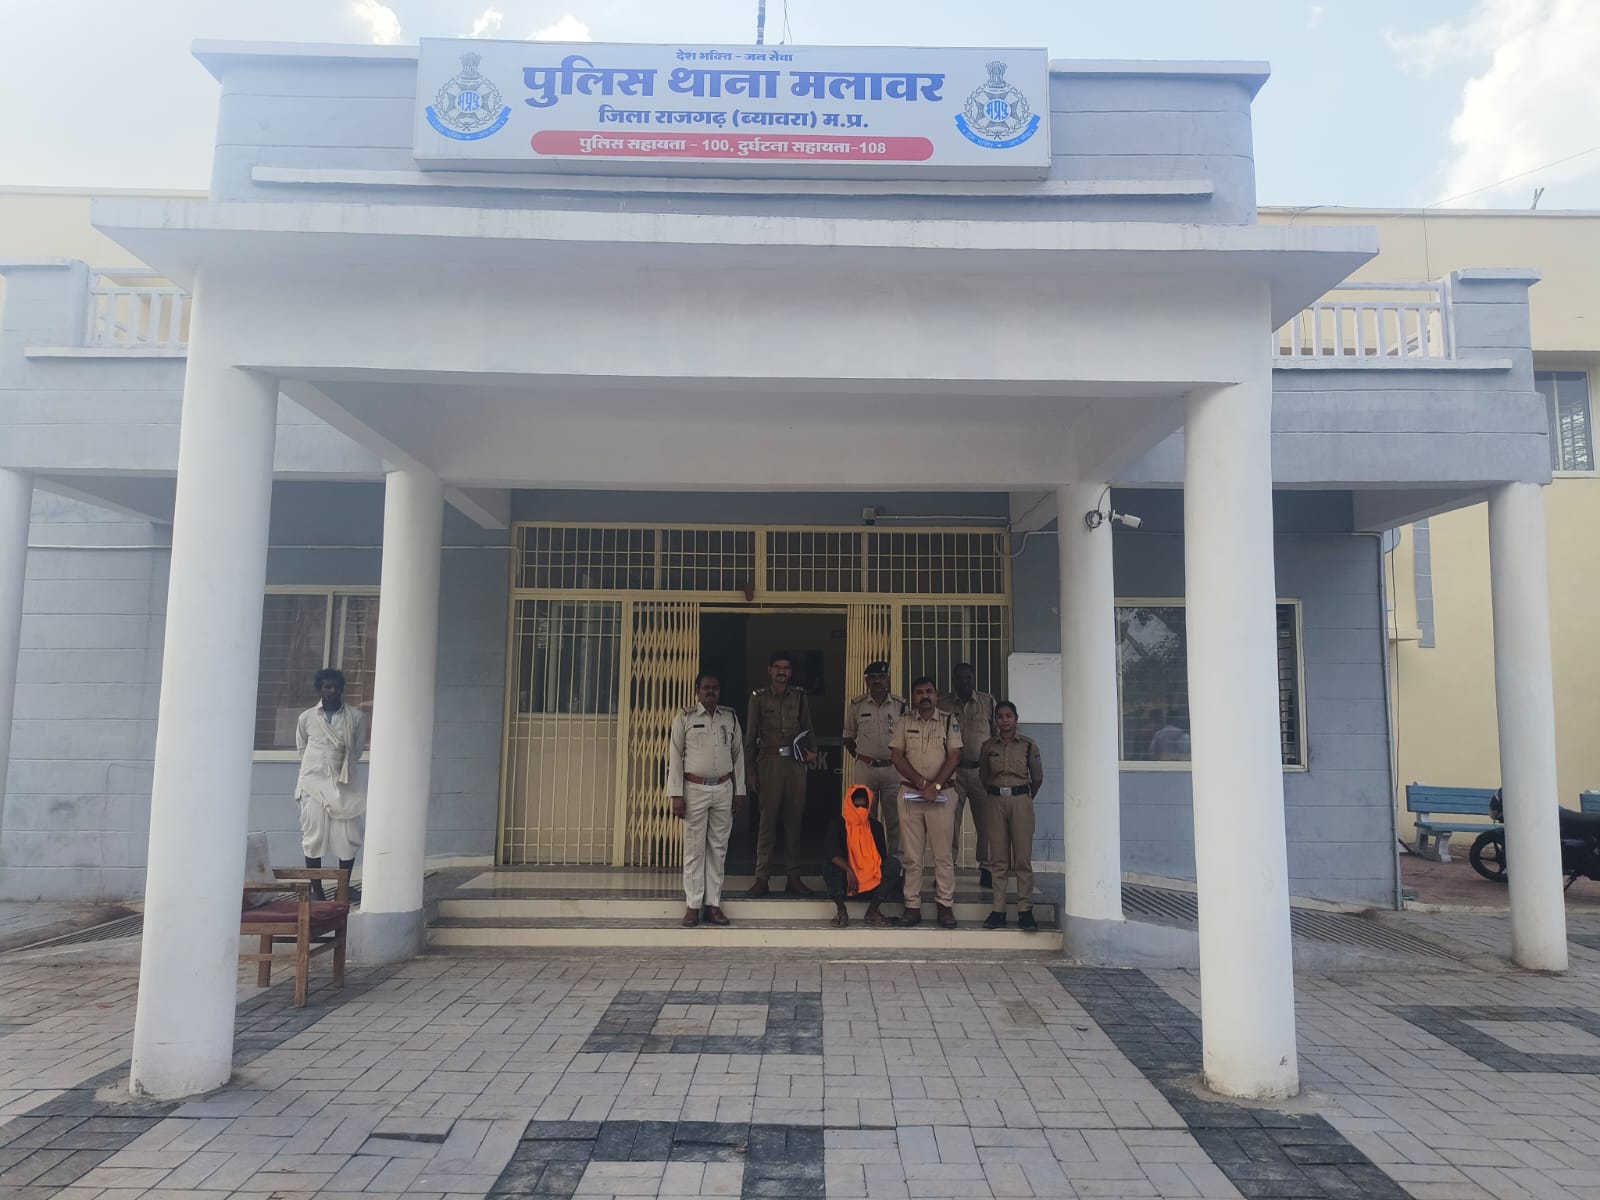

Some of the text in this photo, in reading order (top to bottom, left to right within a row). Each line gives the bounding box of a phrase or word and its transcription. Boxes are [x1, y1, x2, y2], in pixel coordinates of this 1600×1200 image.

[676, 49, 696, 61] देश
[699, 49, 732, 61] भक्ति
[743, 52, 766, 61] जन
[769, 51, 793, 62] सेवा
[522, 55, 945, 108] पुलिस थाना मलावर
[598, 105, 869, 129] जिला राजगढ़ (ब्यावरा) म.प्र.
[579, 135, 624, 152] पुलिस
[627, 137, 686, 152] सहायता
[737, 139, 789, 156] दुर्घटना
